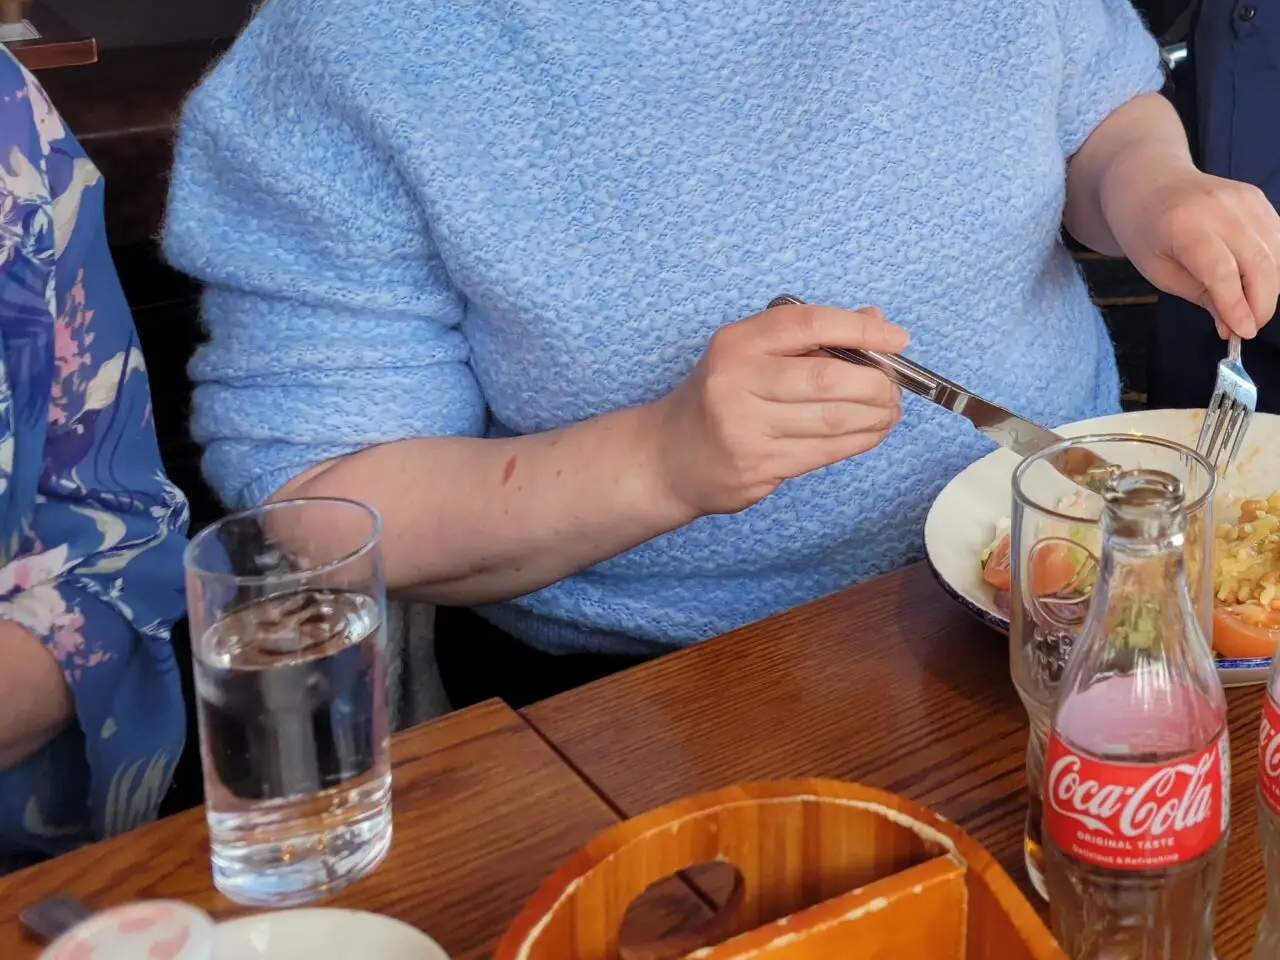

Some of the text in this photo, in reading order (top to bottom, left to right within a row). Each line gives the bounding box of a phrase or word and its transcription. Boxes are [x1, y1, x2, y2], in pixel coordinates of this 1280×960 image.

[1049, 748, 1217, 838] Coca-Cola
[1076, 830, 1133, 850] ORIGINAL
[1136, 837, 1176, 850] TASTE
